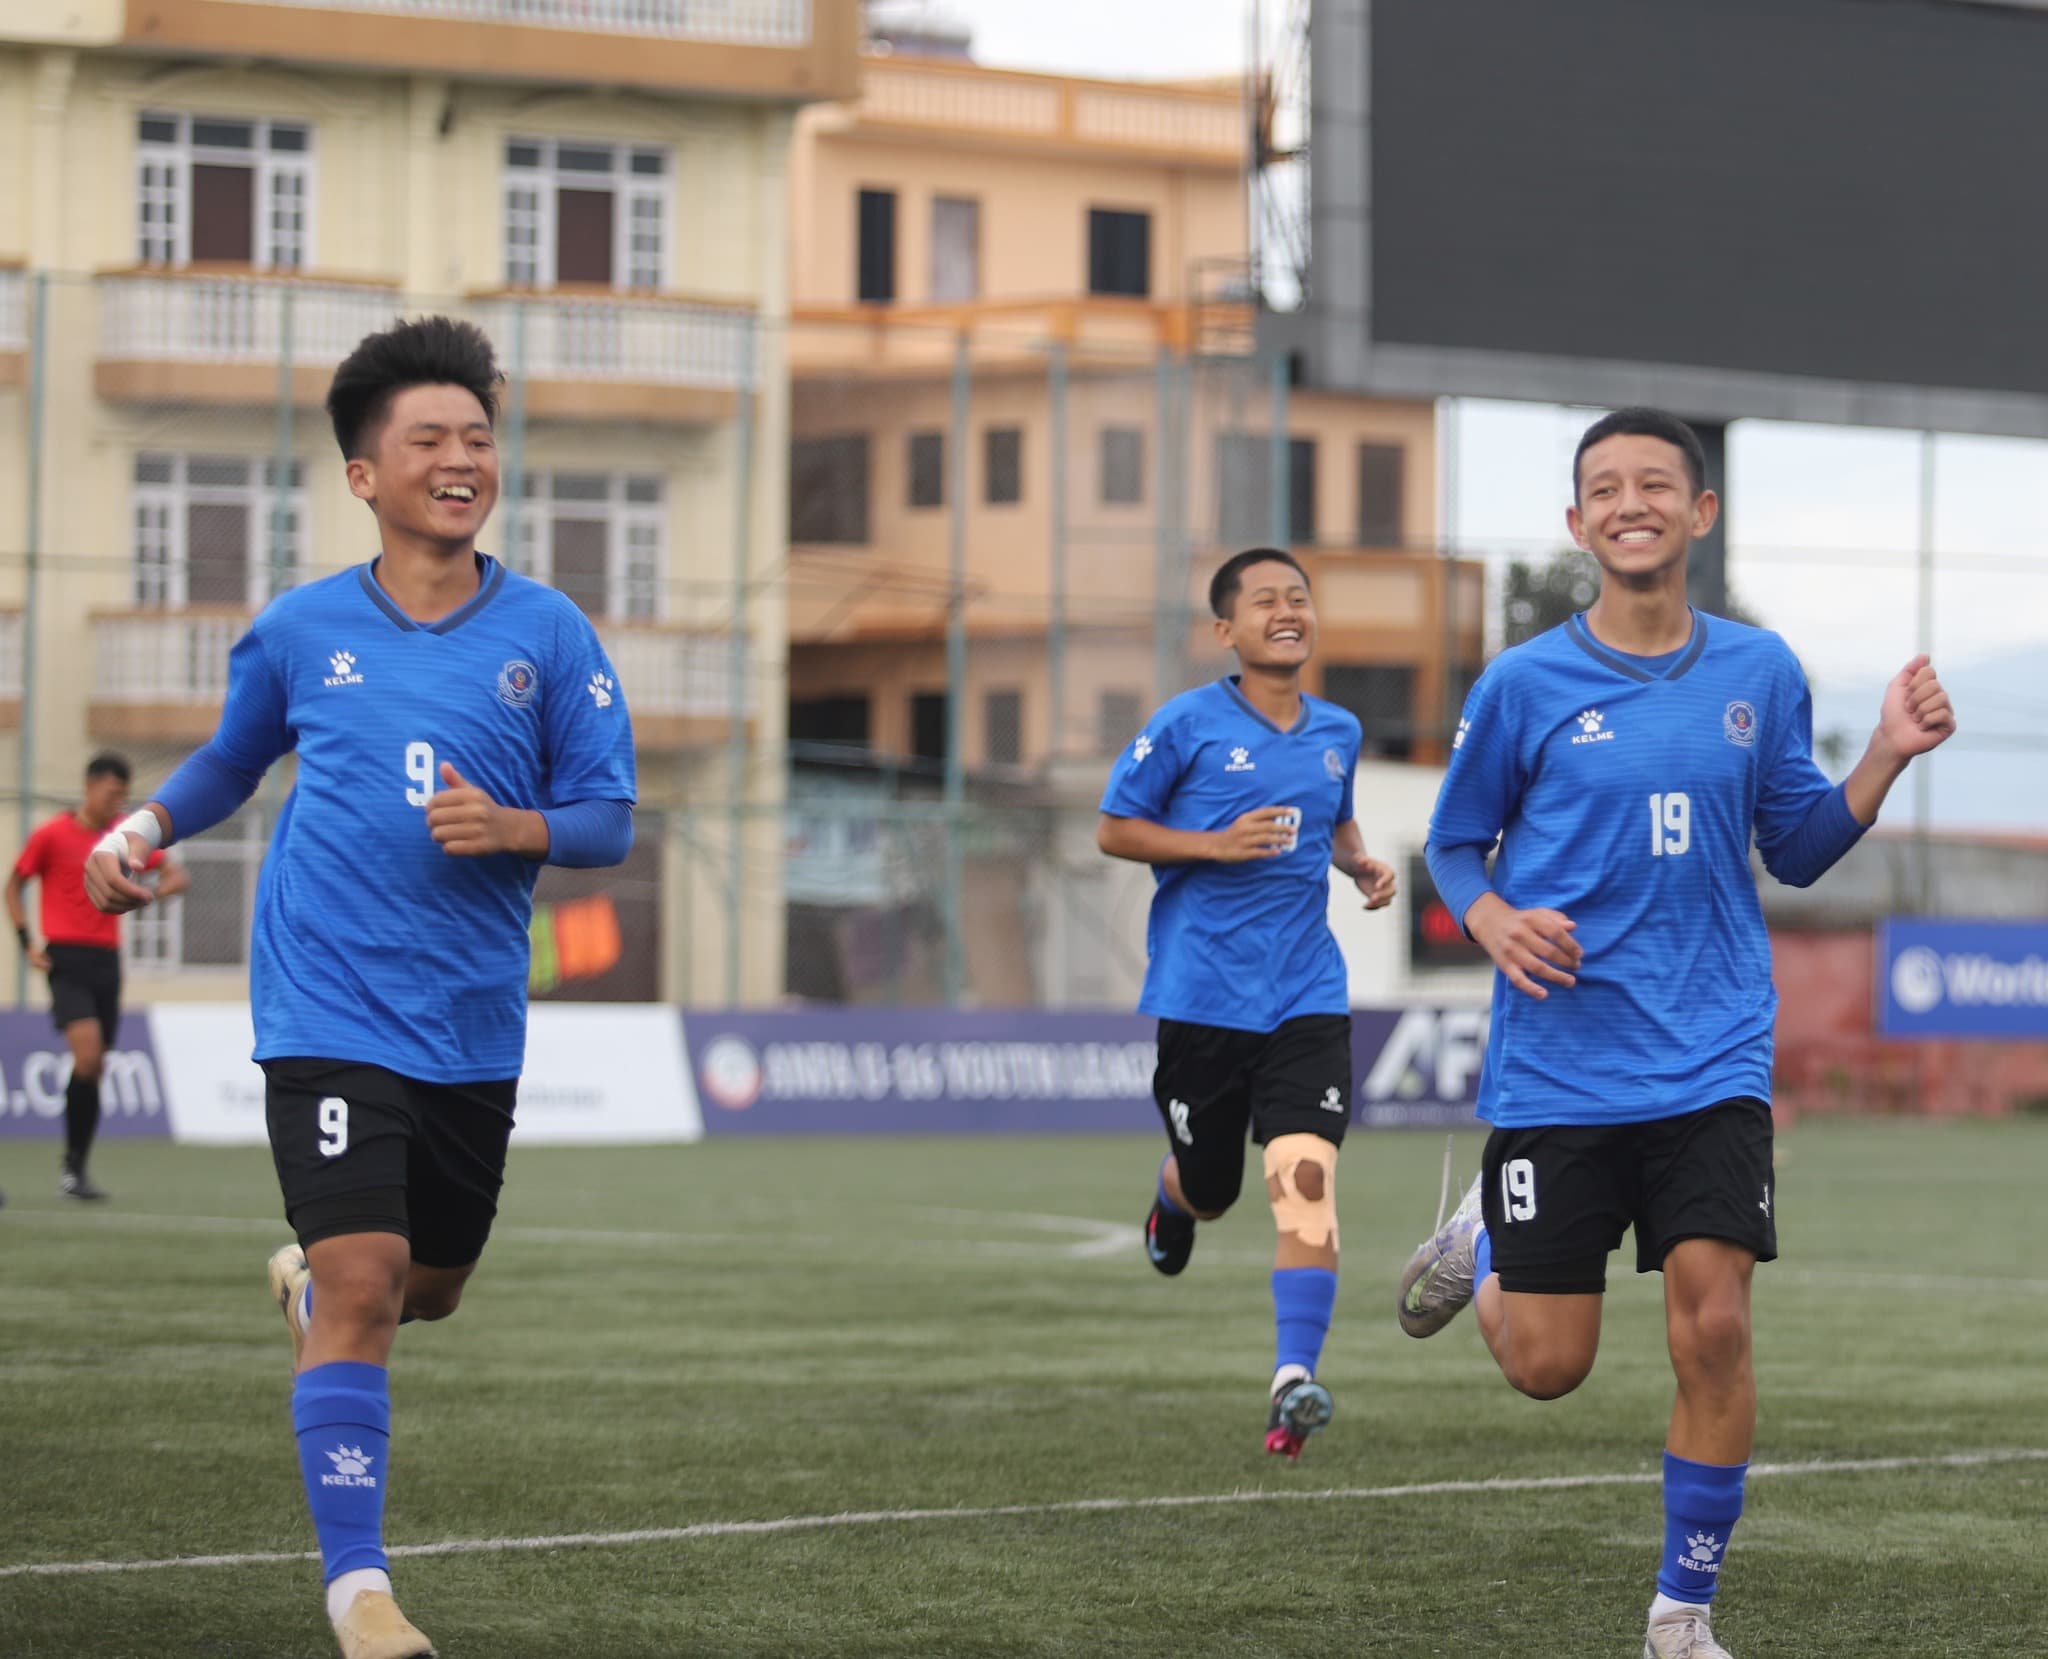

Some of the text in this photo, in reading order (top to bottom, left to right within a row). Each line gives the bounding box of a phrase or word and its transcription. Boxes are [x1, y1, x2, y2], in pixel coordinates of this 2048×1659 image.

[323, 674, 364, 687] KELME
[1572, 731, 1615, 745] KELME
[406, 742, 434, 806] 9
[1650, 792, 1690, 856] 19
[1361, 1007, 1489, 1100] AF
[319, 1097, 348, 1156] 9
[1502, 1159, 1537, 1223] 19
[321, 1474, 376, 1488] KELME
[1678, 1554, 1720, 1573] KELME
